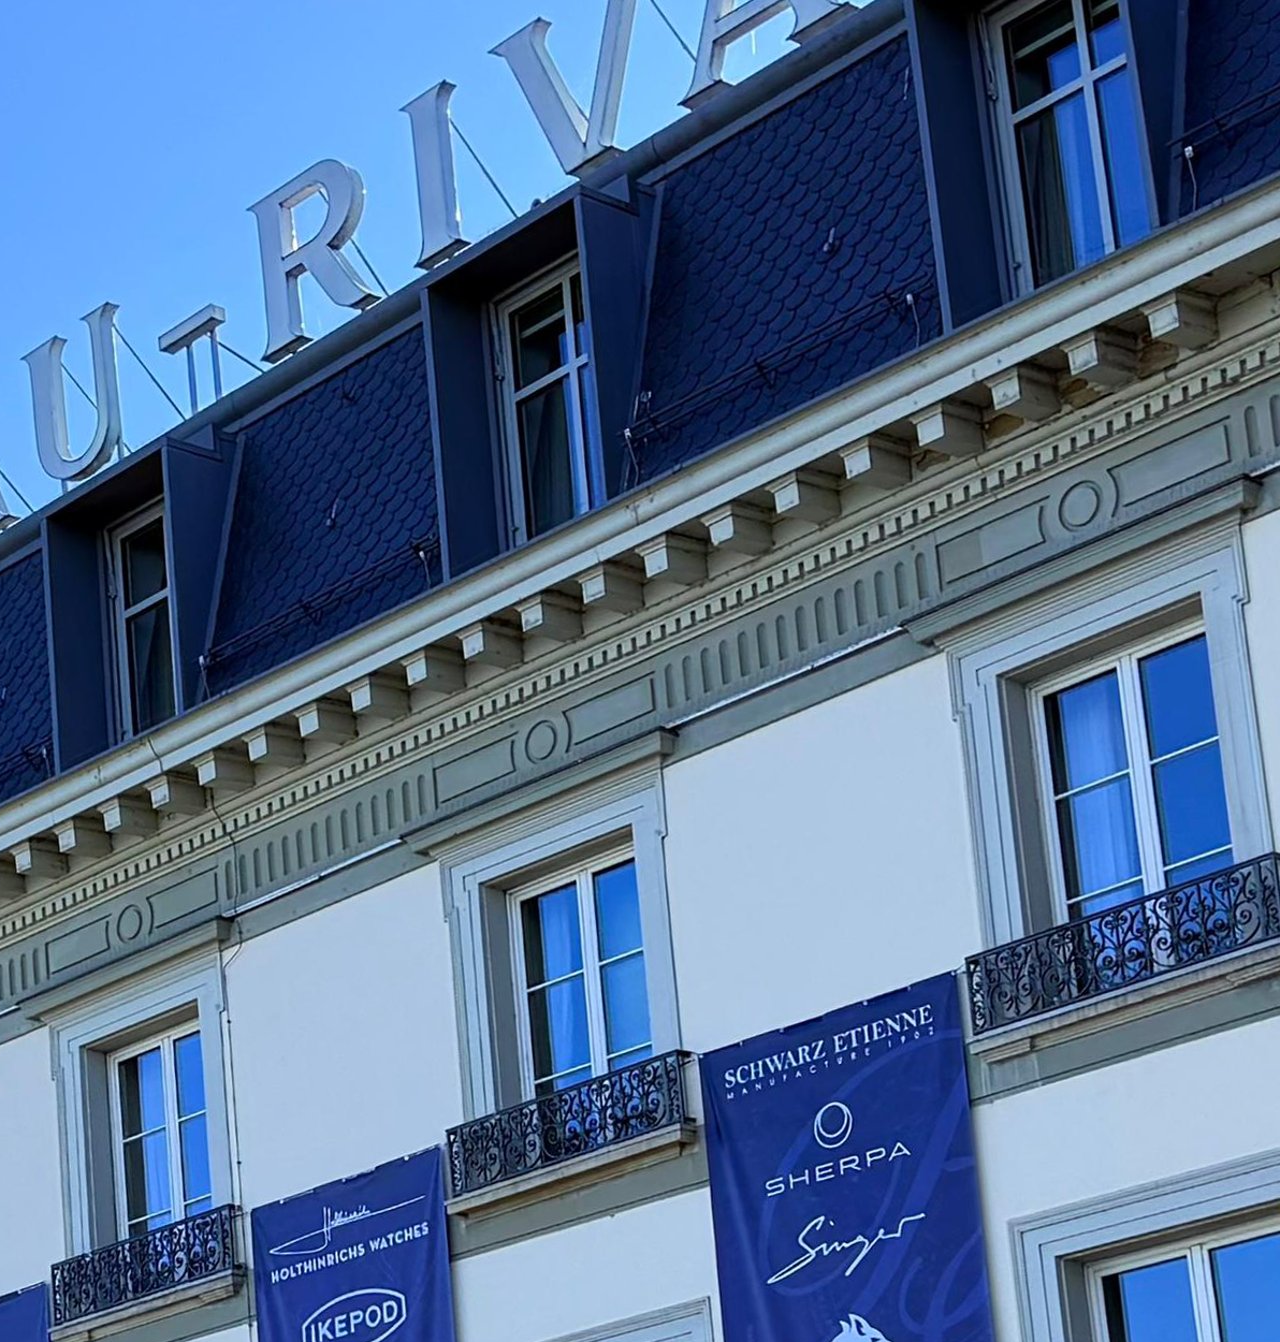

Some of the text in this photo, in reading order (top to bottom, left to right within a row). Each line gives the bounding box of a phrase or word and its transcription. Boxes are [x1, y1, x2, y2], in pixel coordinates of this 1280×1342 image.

[724, 1004, 933, 1088] SCHWARZ ETIENNE
[727, 1047, 871, 1099] MANUFACTURE
[765, 1142, 911, 1197] SHERPA
[271, 1243, 365, 1284] HOLTHINRICHS
[369, 1221, 429, 1252] WATCHES
